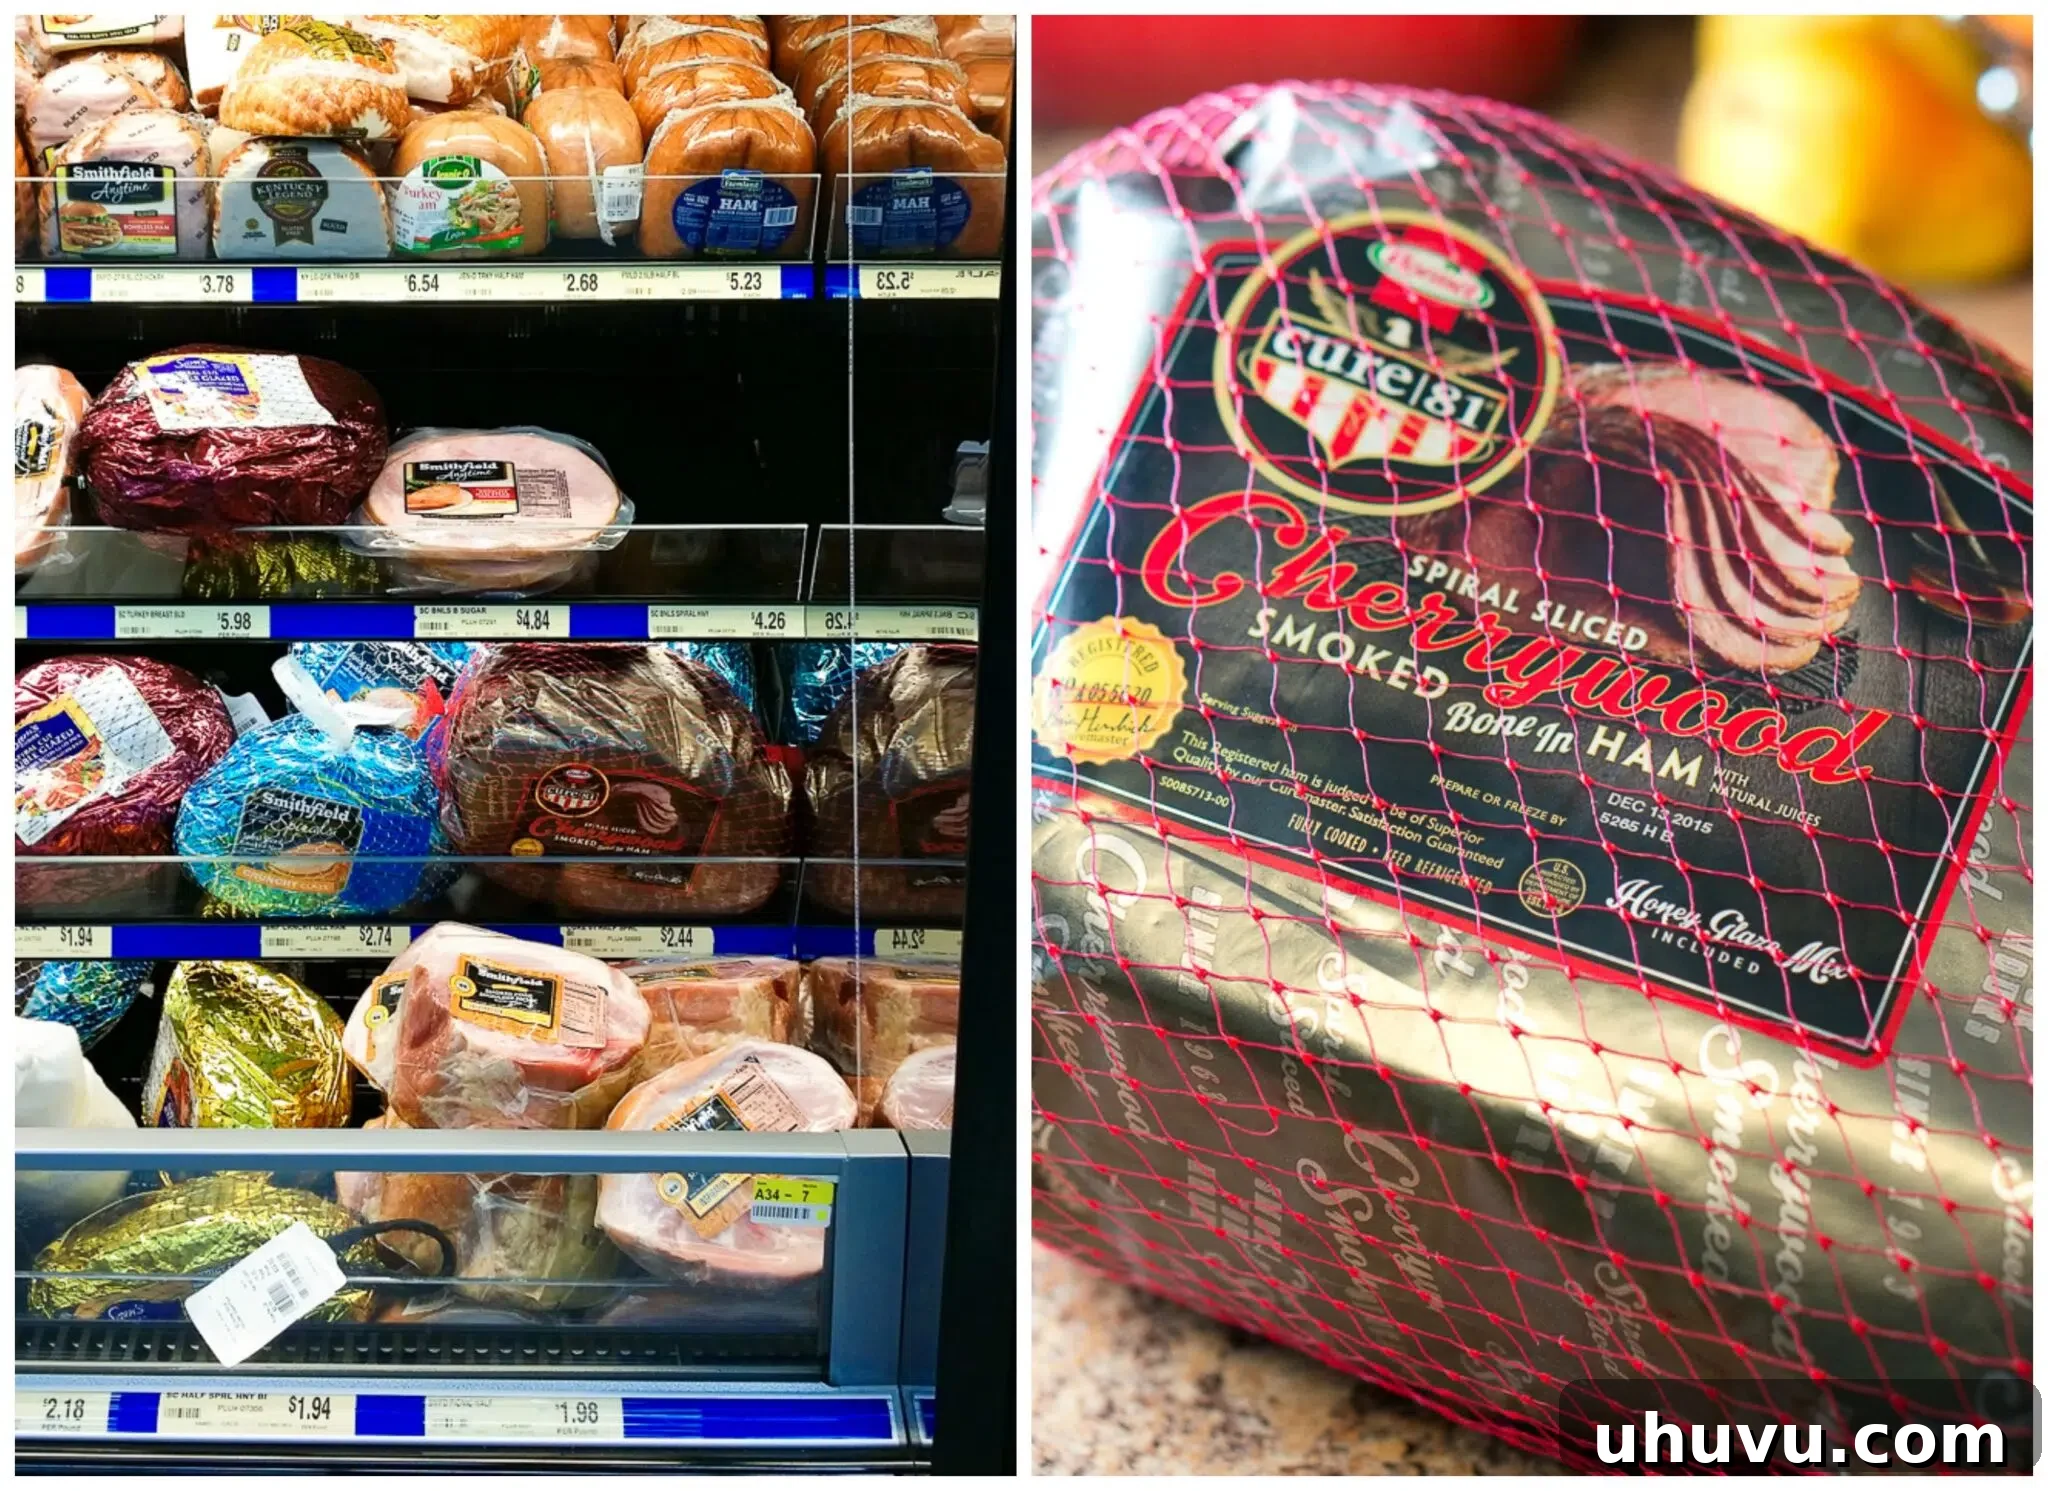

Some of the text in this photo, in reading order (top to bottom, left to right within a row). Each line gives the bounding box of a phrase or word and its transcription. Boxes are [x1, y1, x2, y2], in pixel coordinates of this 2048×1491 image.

[72, 165, 155, 184] Smithfield
[90, 182, 150, 204] Anytime
[255, 181, 324, 194] KENTUCKY
[267, 190, 314, 199] LEGEND
[719, 198, 758, 211] HAM
[419, 461, 499, 471] Smithfield
[436, 469, 494, 481] Anytime
[1406, 553, 1650, 652] SPIRAL SLICED
[516, 608, 550, 630] $4.84
[1140, 489, 1893, 785] Cherrywood
[1247, 606, 1451, 701] SMOKED
[1200, 691, 1240, 716] Serving
[1443, 701, 1705, 789] Bone In HAM
[1181, 729, 1486, 845] This Registered ham is judged be of Superior
[1713, 765, 1749, 788] WITH
[262, 791, 350, 822] Smithfield
[1172, 746, 1222, 776] Quality
[1225, 762, 1241, 781] by
[1241, 774, 1266, 787] our
[1347, 805, 1424, 844] Satisfaction
[1425, 834, 1506, 870] Guaranteed
[1428, 773, 1568, 828] PREPARE OR FREEZE BY
[1709, 780, 1822, 828] NATURAL JUICES
[1606, 791, 1715, 835] DEC 13 2015
[1599, 811, 1641, 833] 5265
[1642, 823, 1659, 839] H
[554, 834, 598, 847] SMOKED
[625, 846, 651, 855] HAM
[1286, 812, 1322, 842] FULLY
[1322, 825, 1368, 854] COOKED
[1382, 848, 1413, 869] KEEP
[242, 869, 297, 887] CRUNCHY
[60, 925, 93, 947] $1.94
[359, 925, 392, 946] $2.74
[660, 925, 694, 947] $2.44
[1604, 878, 1702, 930] Honey
[1707, 908, 1785, 957] Glaze
[1774, 941, 1850, 985] Mix
[1651, 927, 1762, 976] INCLUDED
[478, 967, 545, 987] Smithfield
[754, 1188, 780, 1201] A34
[802, 1190, 810, 1202] 7
[208, 1392, 232, 1400] SPRL
[235, 1392, 256, 1400] HNY
[288, 1395, 331, 1420] $1.94
